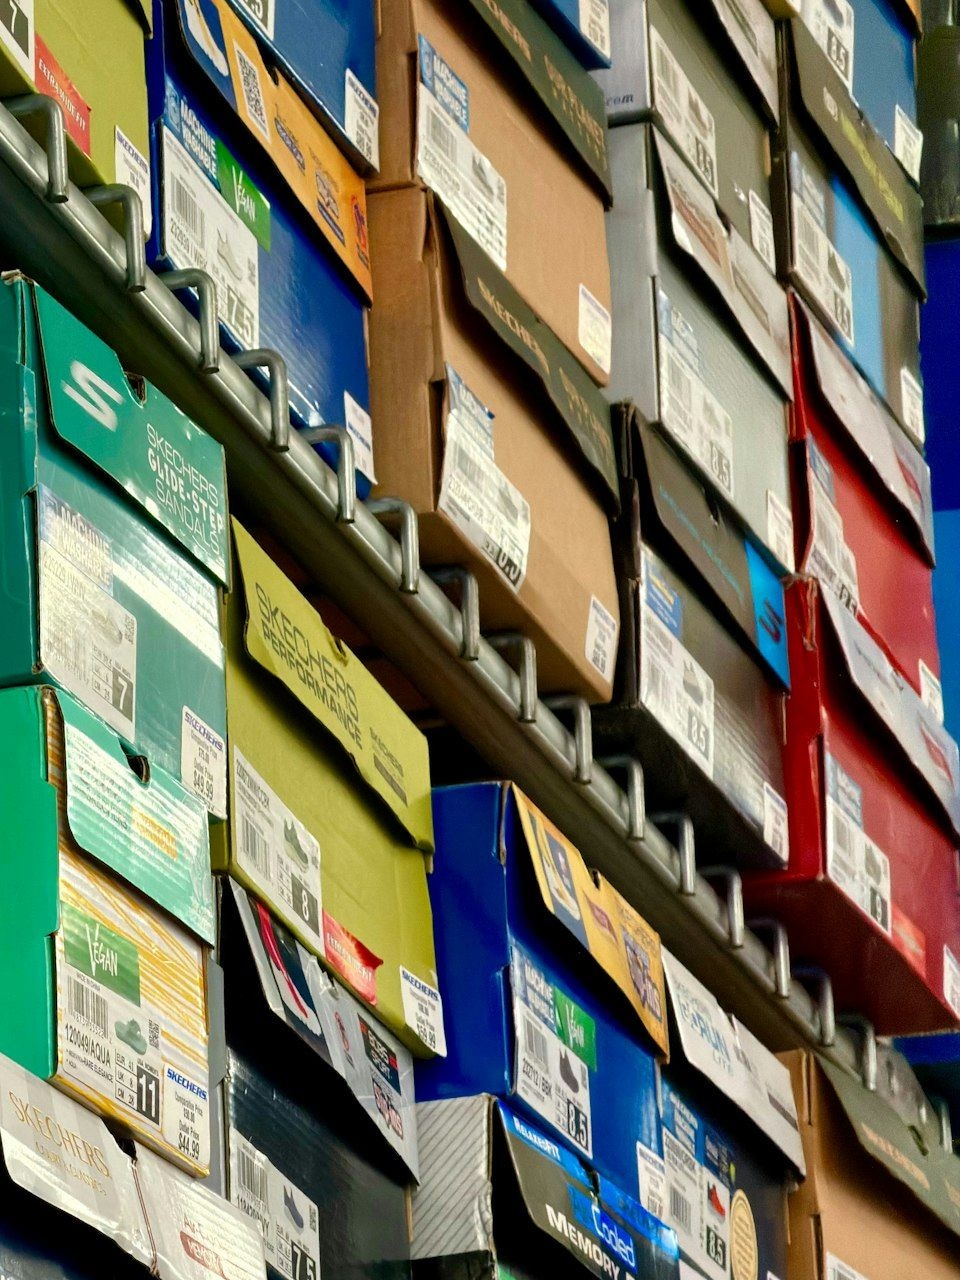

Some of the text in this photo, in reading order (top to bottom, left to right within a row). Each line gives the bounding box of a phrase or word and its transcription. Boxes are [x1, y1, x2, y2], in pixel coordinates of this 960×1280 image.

[116, 131, 150, 175] SKECHERS
[147, 422, 219, 505] SKECHERS
[147, 454, 224, 535] GLIDE-STEP
[156, 480, 221, 554] SANDALS
[255, 582, 360, 723] SKECHERS
[261, 618, 363, 751] PERFORMANCE
[185, 712, 224, 752] SKECHERS
[85, 922, 119, 977] VEGAN
[401, 968, 440, 1002] SKECHERS
[64, 1024, 112, 1067] 120049/AQUA
[166, 1067, 208, 1102] SKECHERS
[8, 1090, 112, 1179] SKECHERS
[568, 1103, 588, 1151] 8.5
